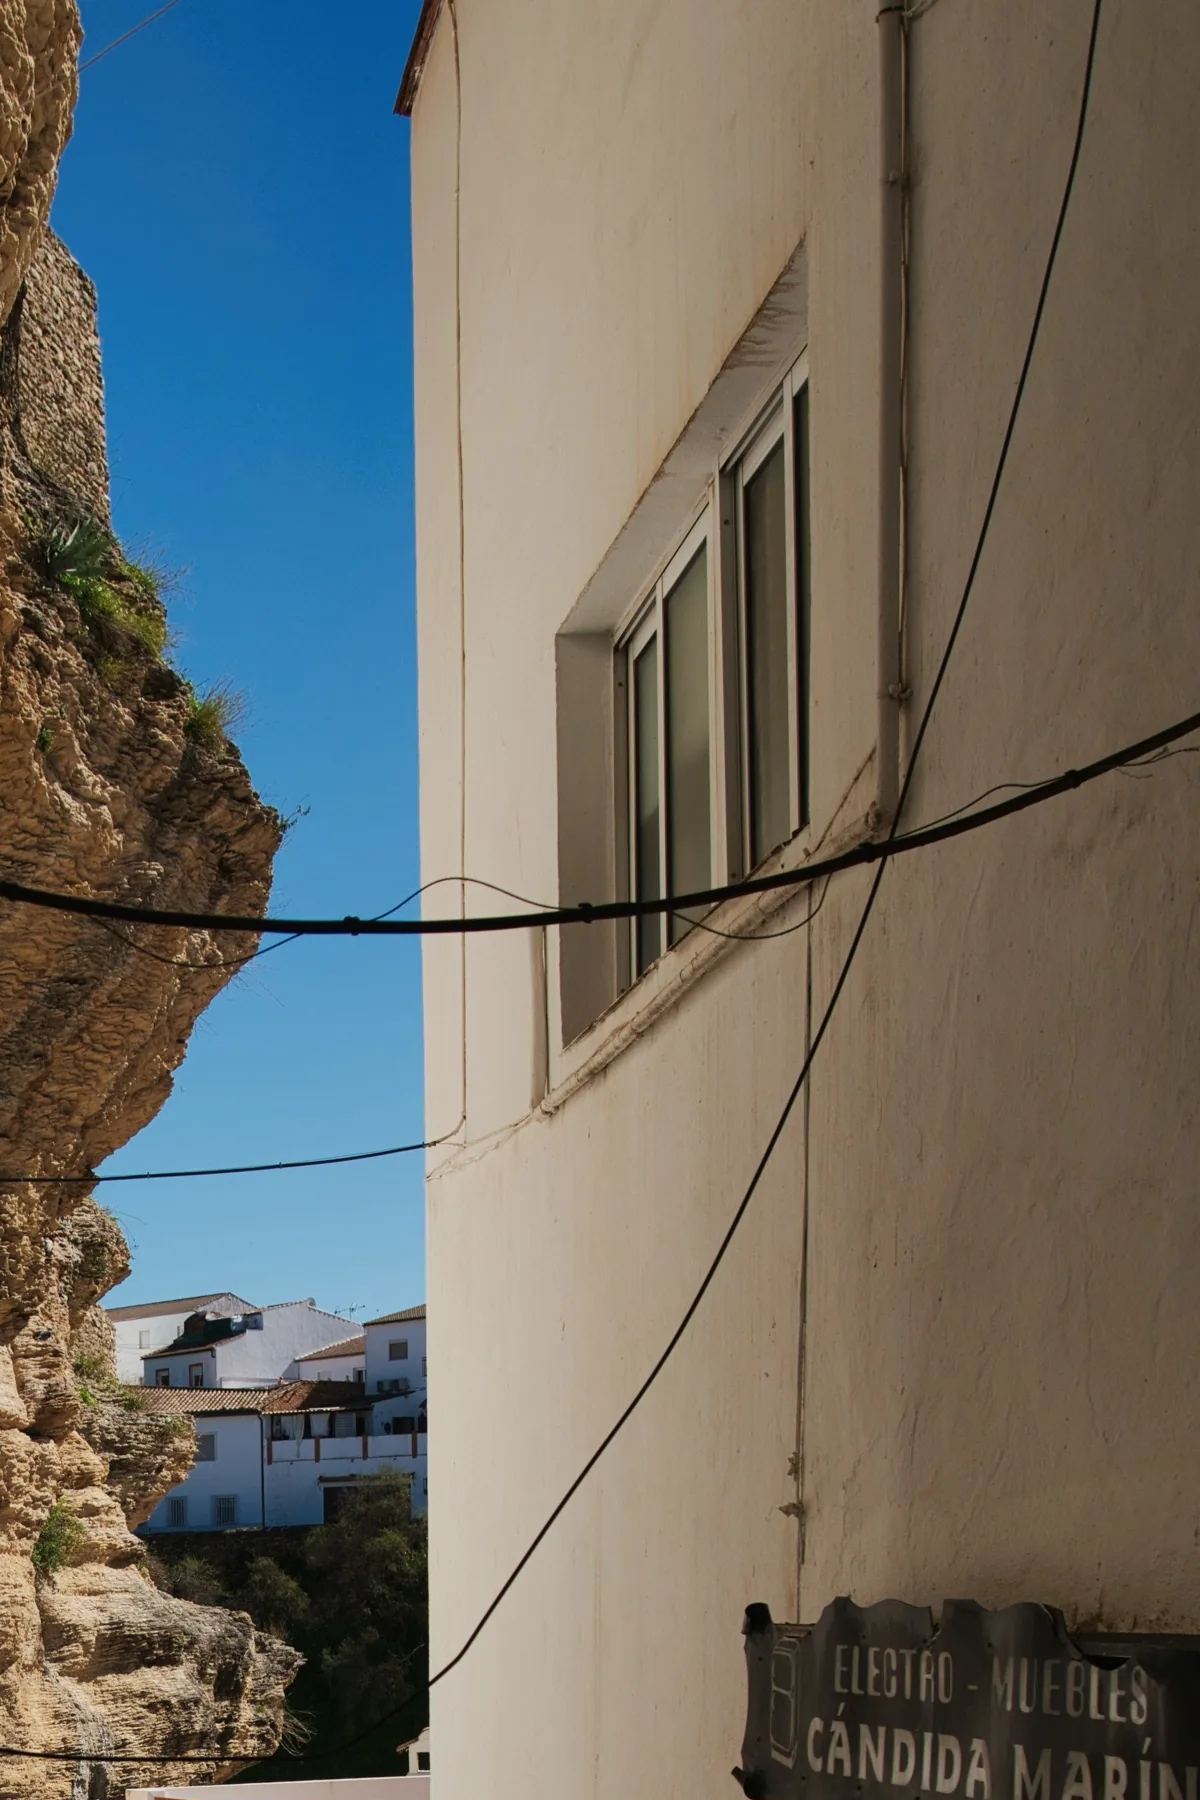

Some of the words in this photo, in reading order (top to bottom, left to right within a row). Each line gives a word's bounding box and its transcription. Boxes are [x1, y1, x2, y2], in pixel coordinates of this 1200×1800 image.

[833, 1644, 955, 1704] ELECTRO
[992, 1655, 1148, 1726] MUEBLES
[806, 1702, 992, 1800] CÁNDIDA
